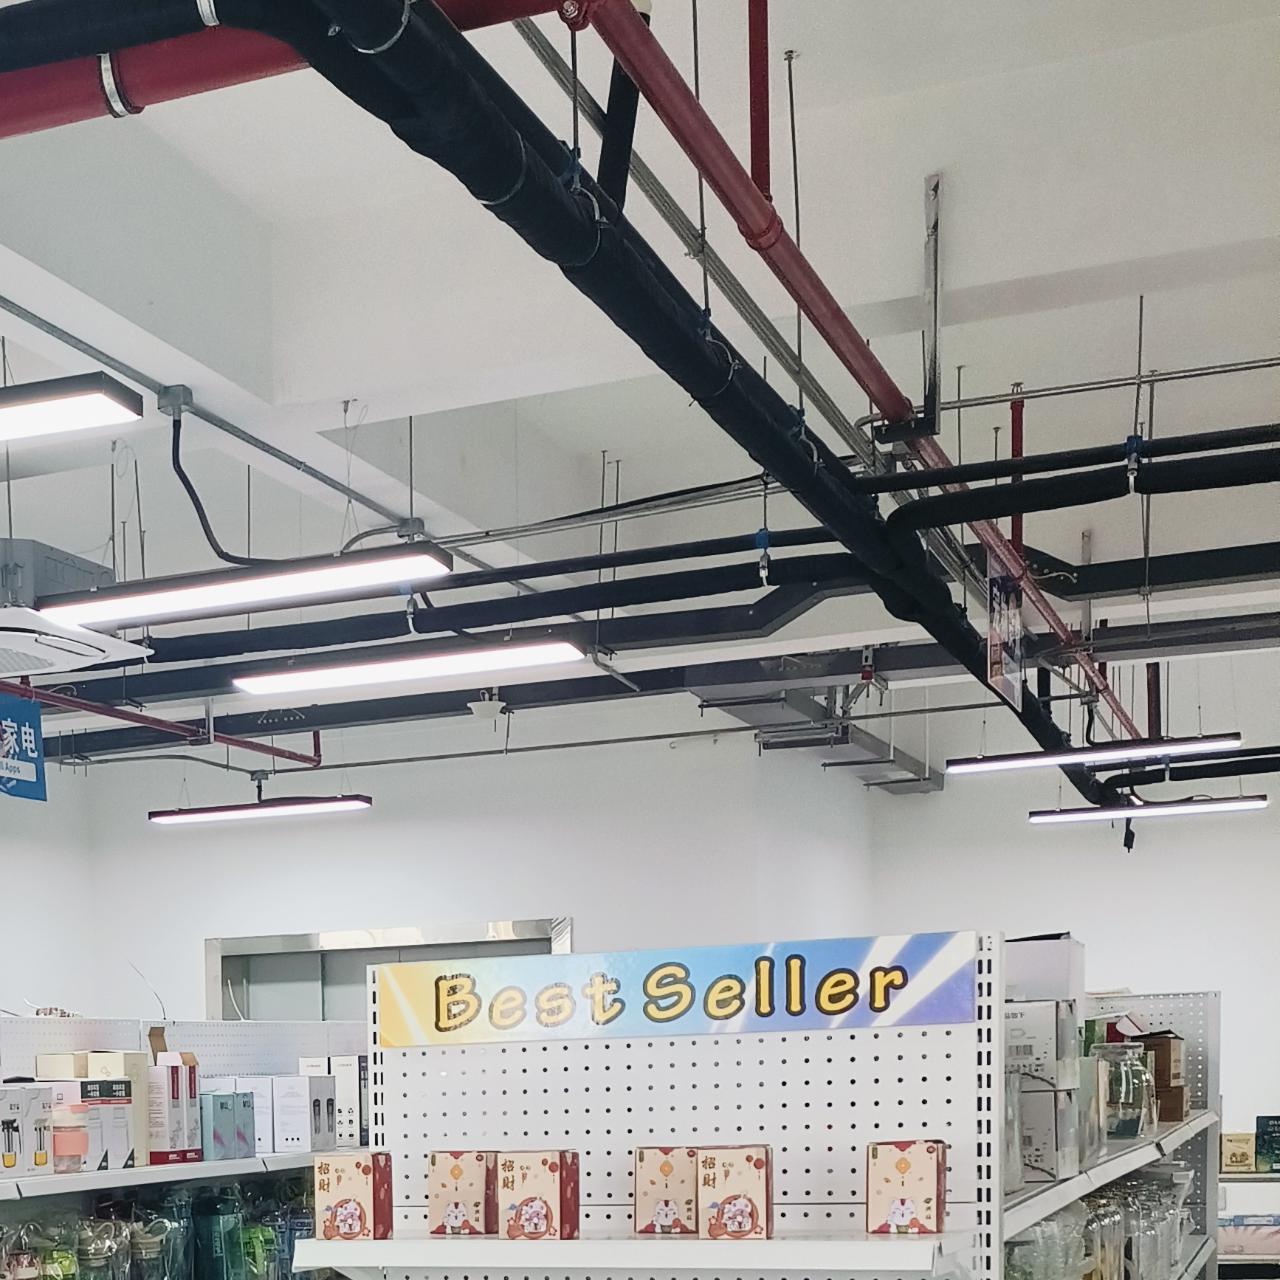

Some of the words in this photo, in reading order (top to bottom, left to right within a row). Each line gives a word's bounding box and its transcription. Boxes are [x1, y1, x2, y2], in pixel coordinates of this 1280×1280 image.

[5, 761, 22, 775] Apps
[432, 971, 626, 1032] Best
[642, 952, 910, 1024] Seller
